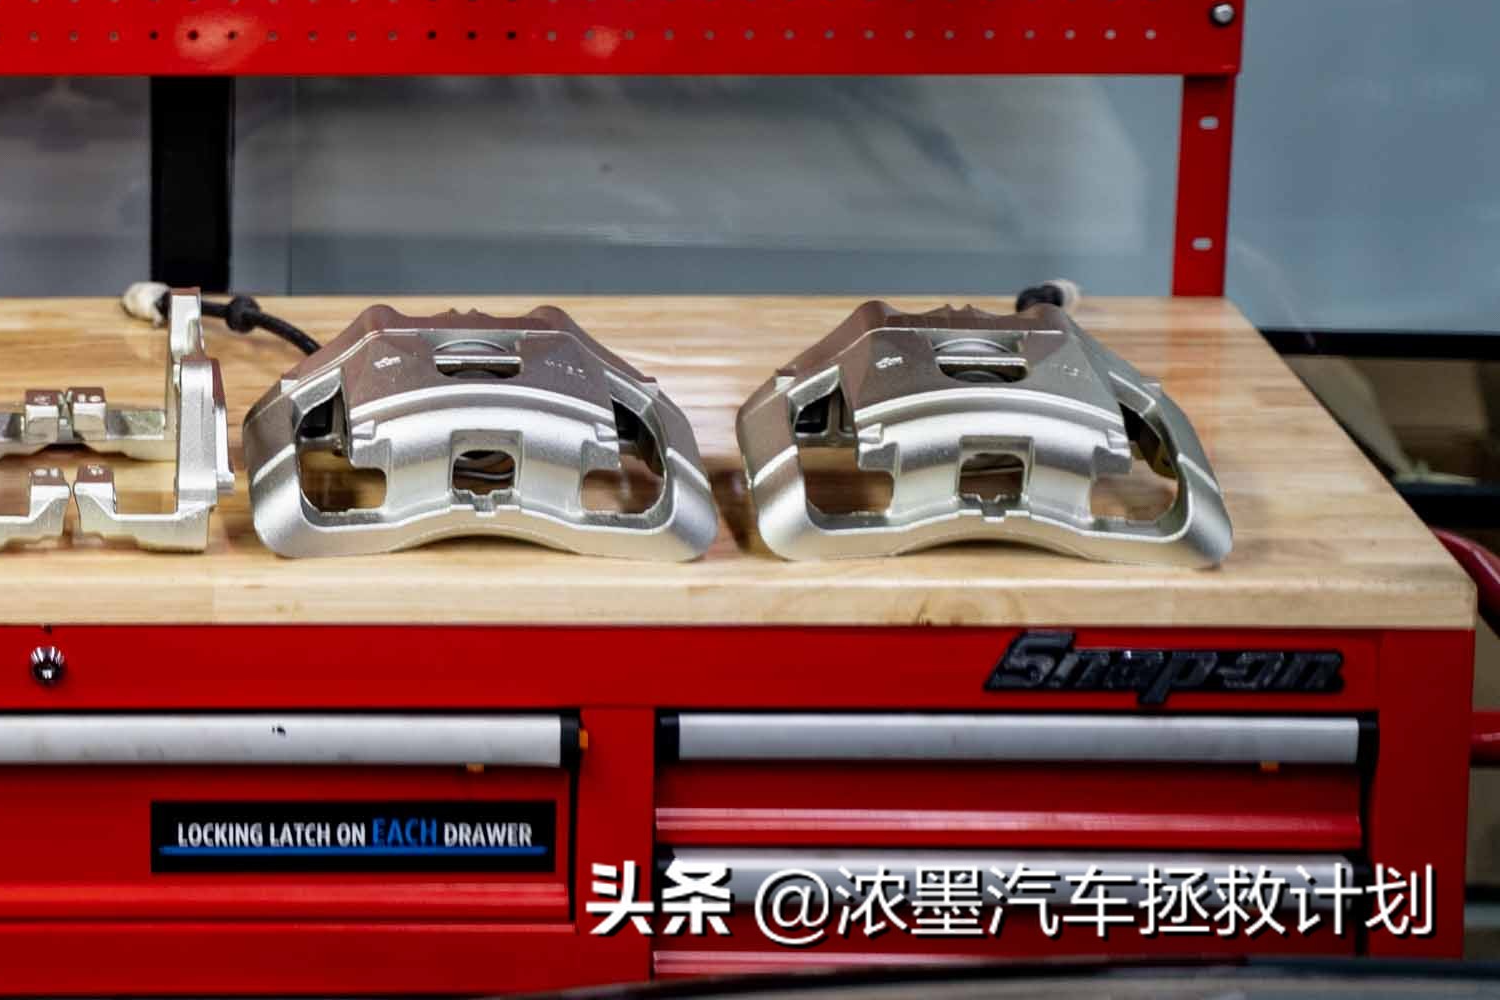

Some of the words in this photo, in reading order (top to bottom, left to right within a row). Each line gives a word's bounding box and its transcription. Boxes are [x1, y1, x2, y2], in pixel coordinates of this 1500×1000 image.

[176, 821, 264, 848] LOCKING
[269, 821, 331, 848] LATCH
[336, 821, 366, 848] ON
[372, 817, 438, 847] EACH
[443, 821, 534, 848] DRAWER
